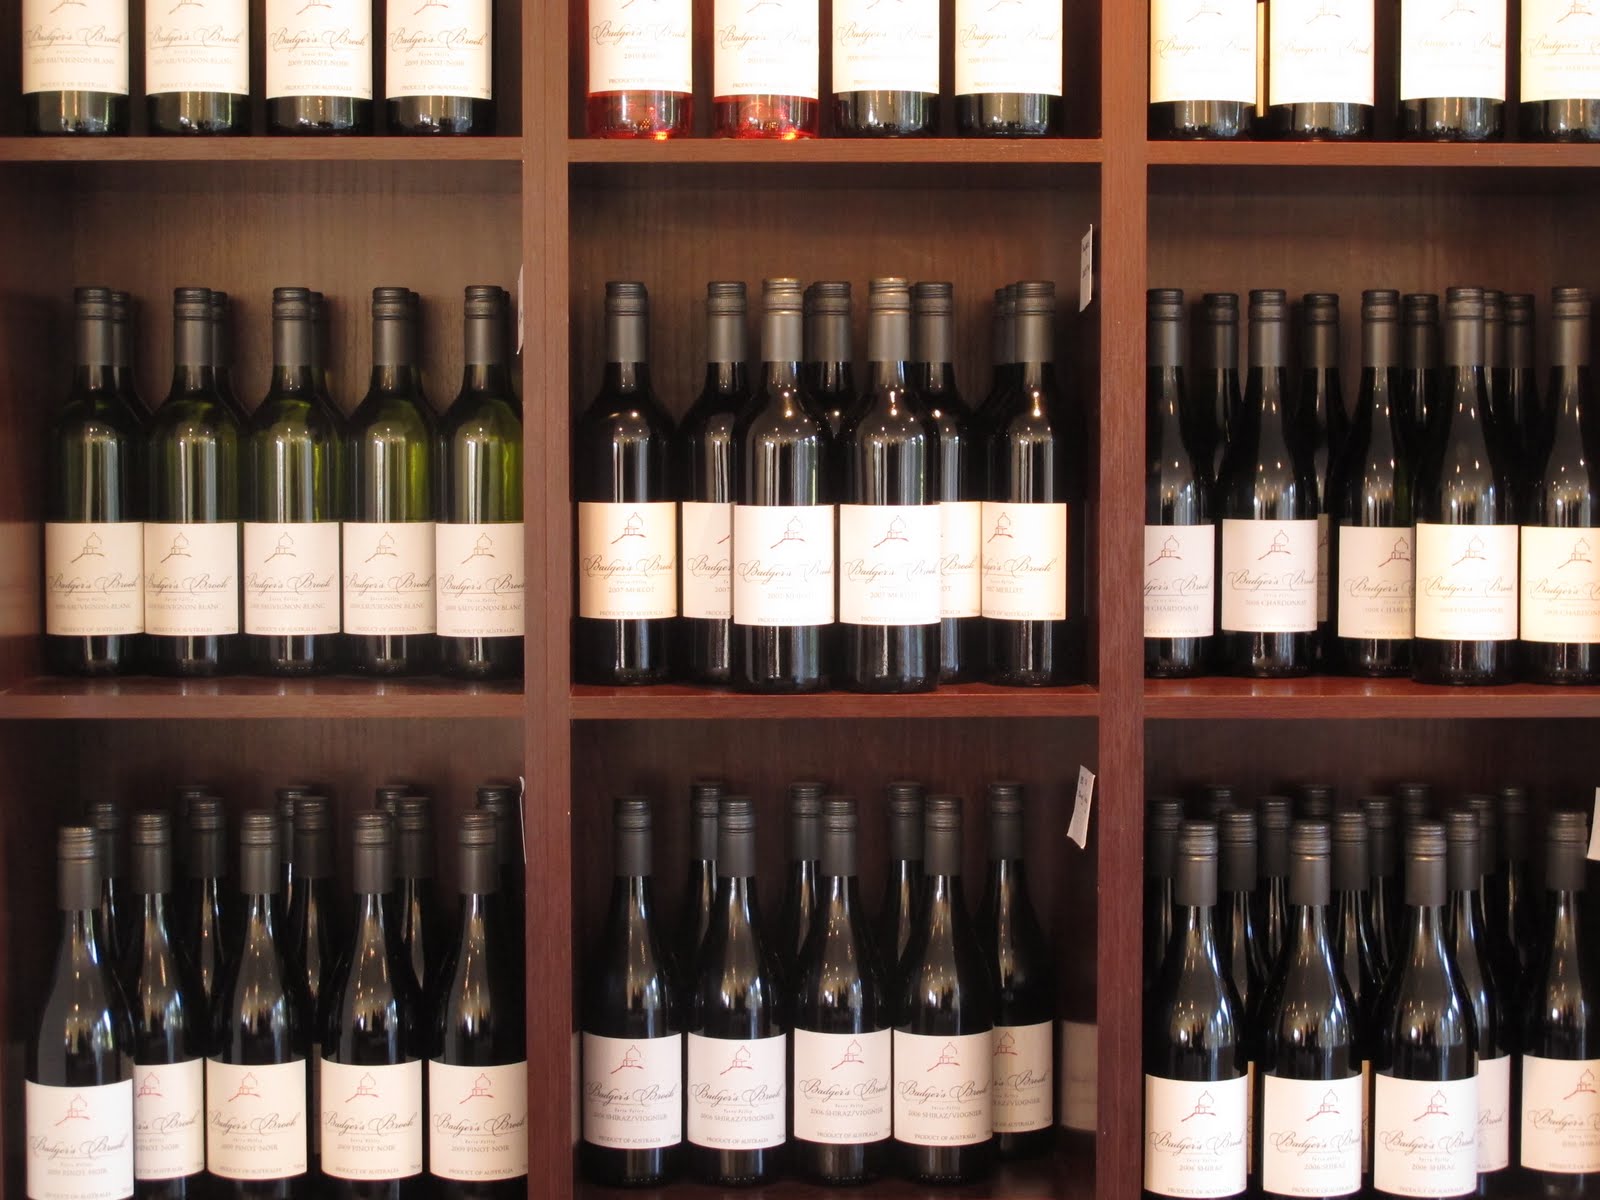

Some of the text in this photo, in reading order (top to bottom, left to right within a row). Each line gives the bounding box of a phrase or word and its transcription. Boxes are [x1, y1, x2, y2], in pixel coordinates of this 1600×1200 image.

[271, 27, 368, 53] Badger's Brook
[389, 27, 488, 53] Badger's Brook
[583, 554, 633, 580] Badger's
[737, 560, 792, 585] Badger's
[845, 559, 896, 584] Badger's
[1004, 554, 1058, 579] Brook
[49, 572, 139, 597] Badger's Brook
[182, 572, 233, 596] Brook
[246, 571, 335, 597] Badger's Brook
[345, 571, 434, 597] Badger's Brook
[440, 574, 482, 598] Badger's
[608, 586, 624, 594] 2007
[1227, 569, 1279, 592] Badger's
[1343, 575, 1399, 600] Badger's
[1420, 574, 1473, 600] Badger's
[799, 1077, 890, 1103] Badger's Brook
[898, 1079, 990, 1105] Badger's Brook
[1008, 1069, 1049, 1092] Brook
[585, 1081, 678, 1108] Badger's Brook
[691, 1081, 783, 1108] Badger's Brook
[152, 1110, 201, 1135] Brook
[209, 1110, 301, 1135] Badger's Brook
[323, 1111, 418, 1136] Badger's Brook
[713, 1113, 775, 1123] SHIRAZ/VIOGNIER
[825, 1106, 884, 1118] SHIRAZ/VIOGNIER
[921, 1109, 983, 1120] SHIRAZ/VIOGNIER
[1528, 1108, 1584, 1133] Badger's
[433, 1112, 526, 1138] Badger's Brook
[914, 1133, 938, 1142] PRODUCT
[939, 1133, 948, 1142] OF
[30, 1133, 129, 1160] Badger's Brook
[351, 1144, 375, 1153] PINOT
[376, 1144, 396, 1153] NOIR
[451, 1144, 510, 1153] 2009 PINOT NOIR
[1149, 1130, 1203, 1156] Badger's
[1269, 1130, 1327, 1157] Badger's
[1379, 1130, 1435, 1155] Badger's
